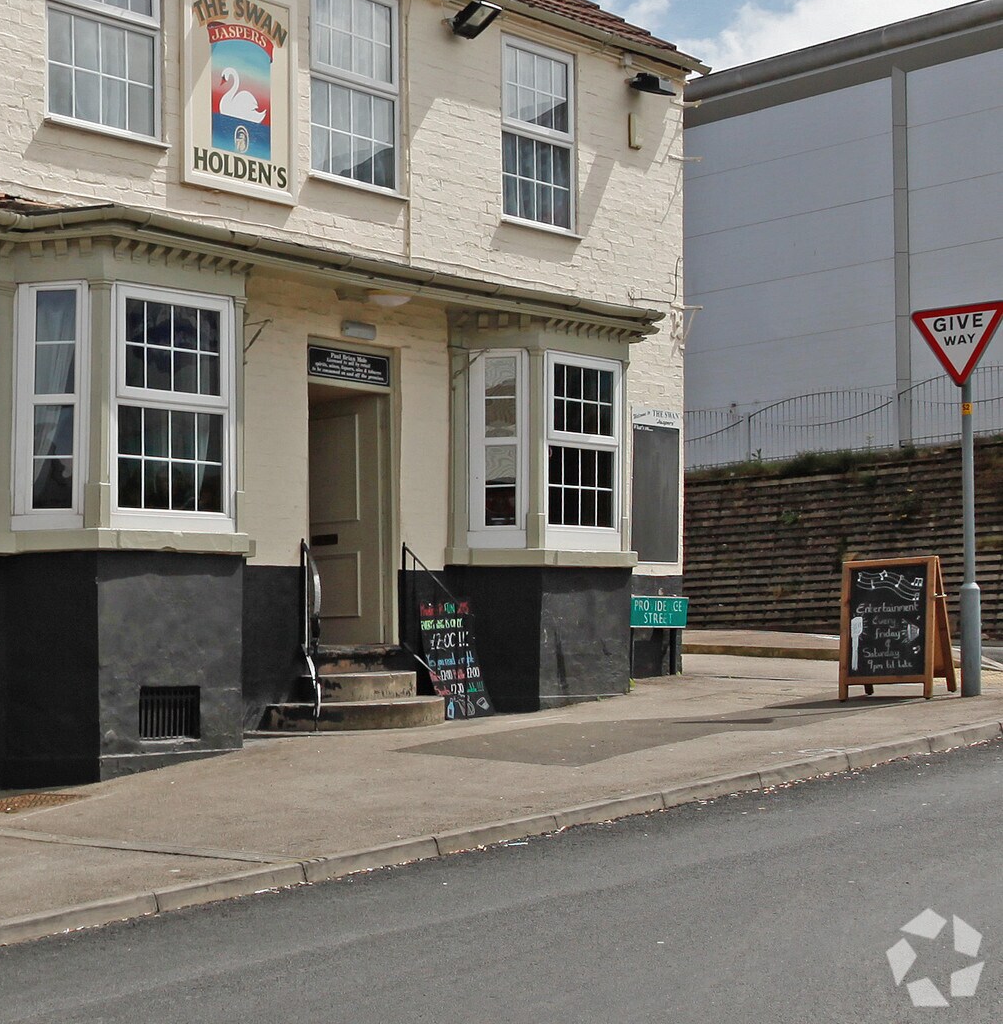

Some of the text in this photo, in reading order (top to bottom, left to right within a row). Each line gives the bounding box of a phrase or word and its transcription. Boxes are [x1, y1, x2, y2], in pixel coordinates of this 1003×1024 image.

[211, 25, 268, 49] JASPERS
[193, 146, 287, 189] HOLDEN'S
[933, 312, 983, 332] GIVE
[944, 333, 976, 346] WAY
[634, 600, 682, 612] PROIDECE
[856, 602, 918, 614] Entertainment
[863, 647, 899, 658] Saturday
